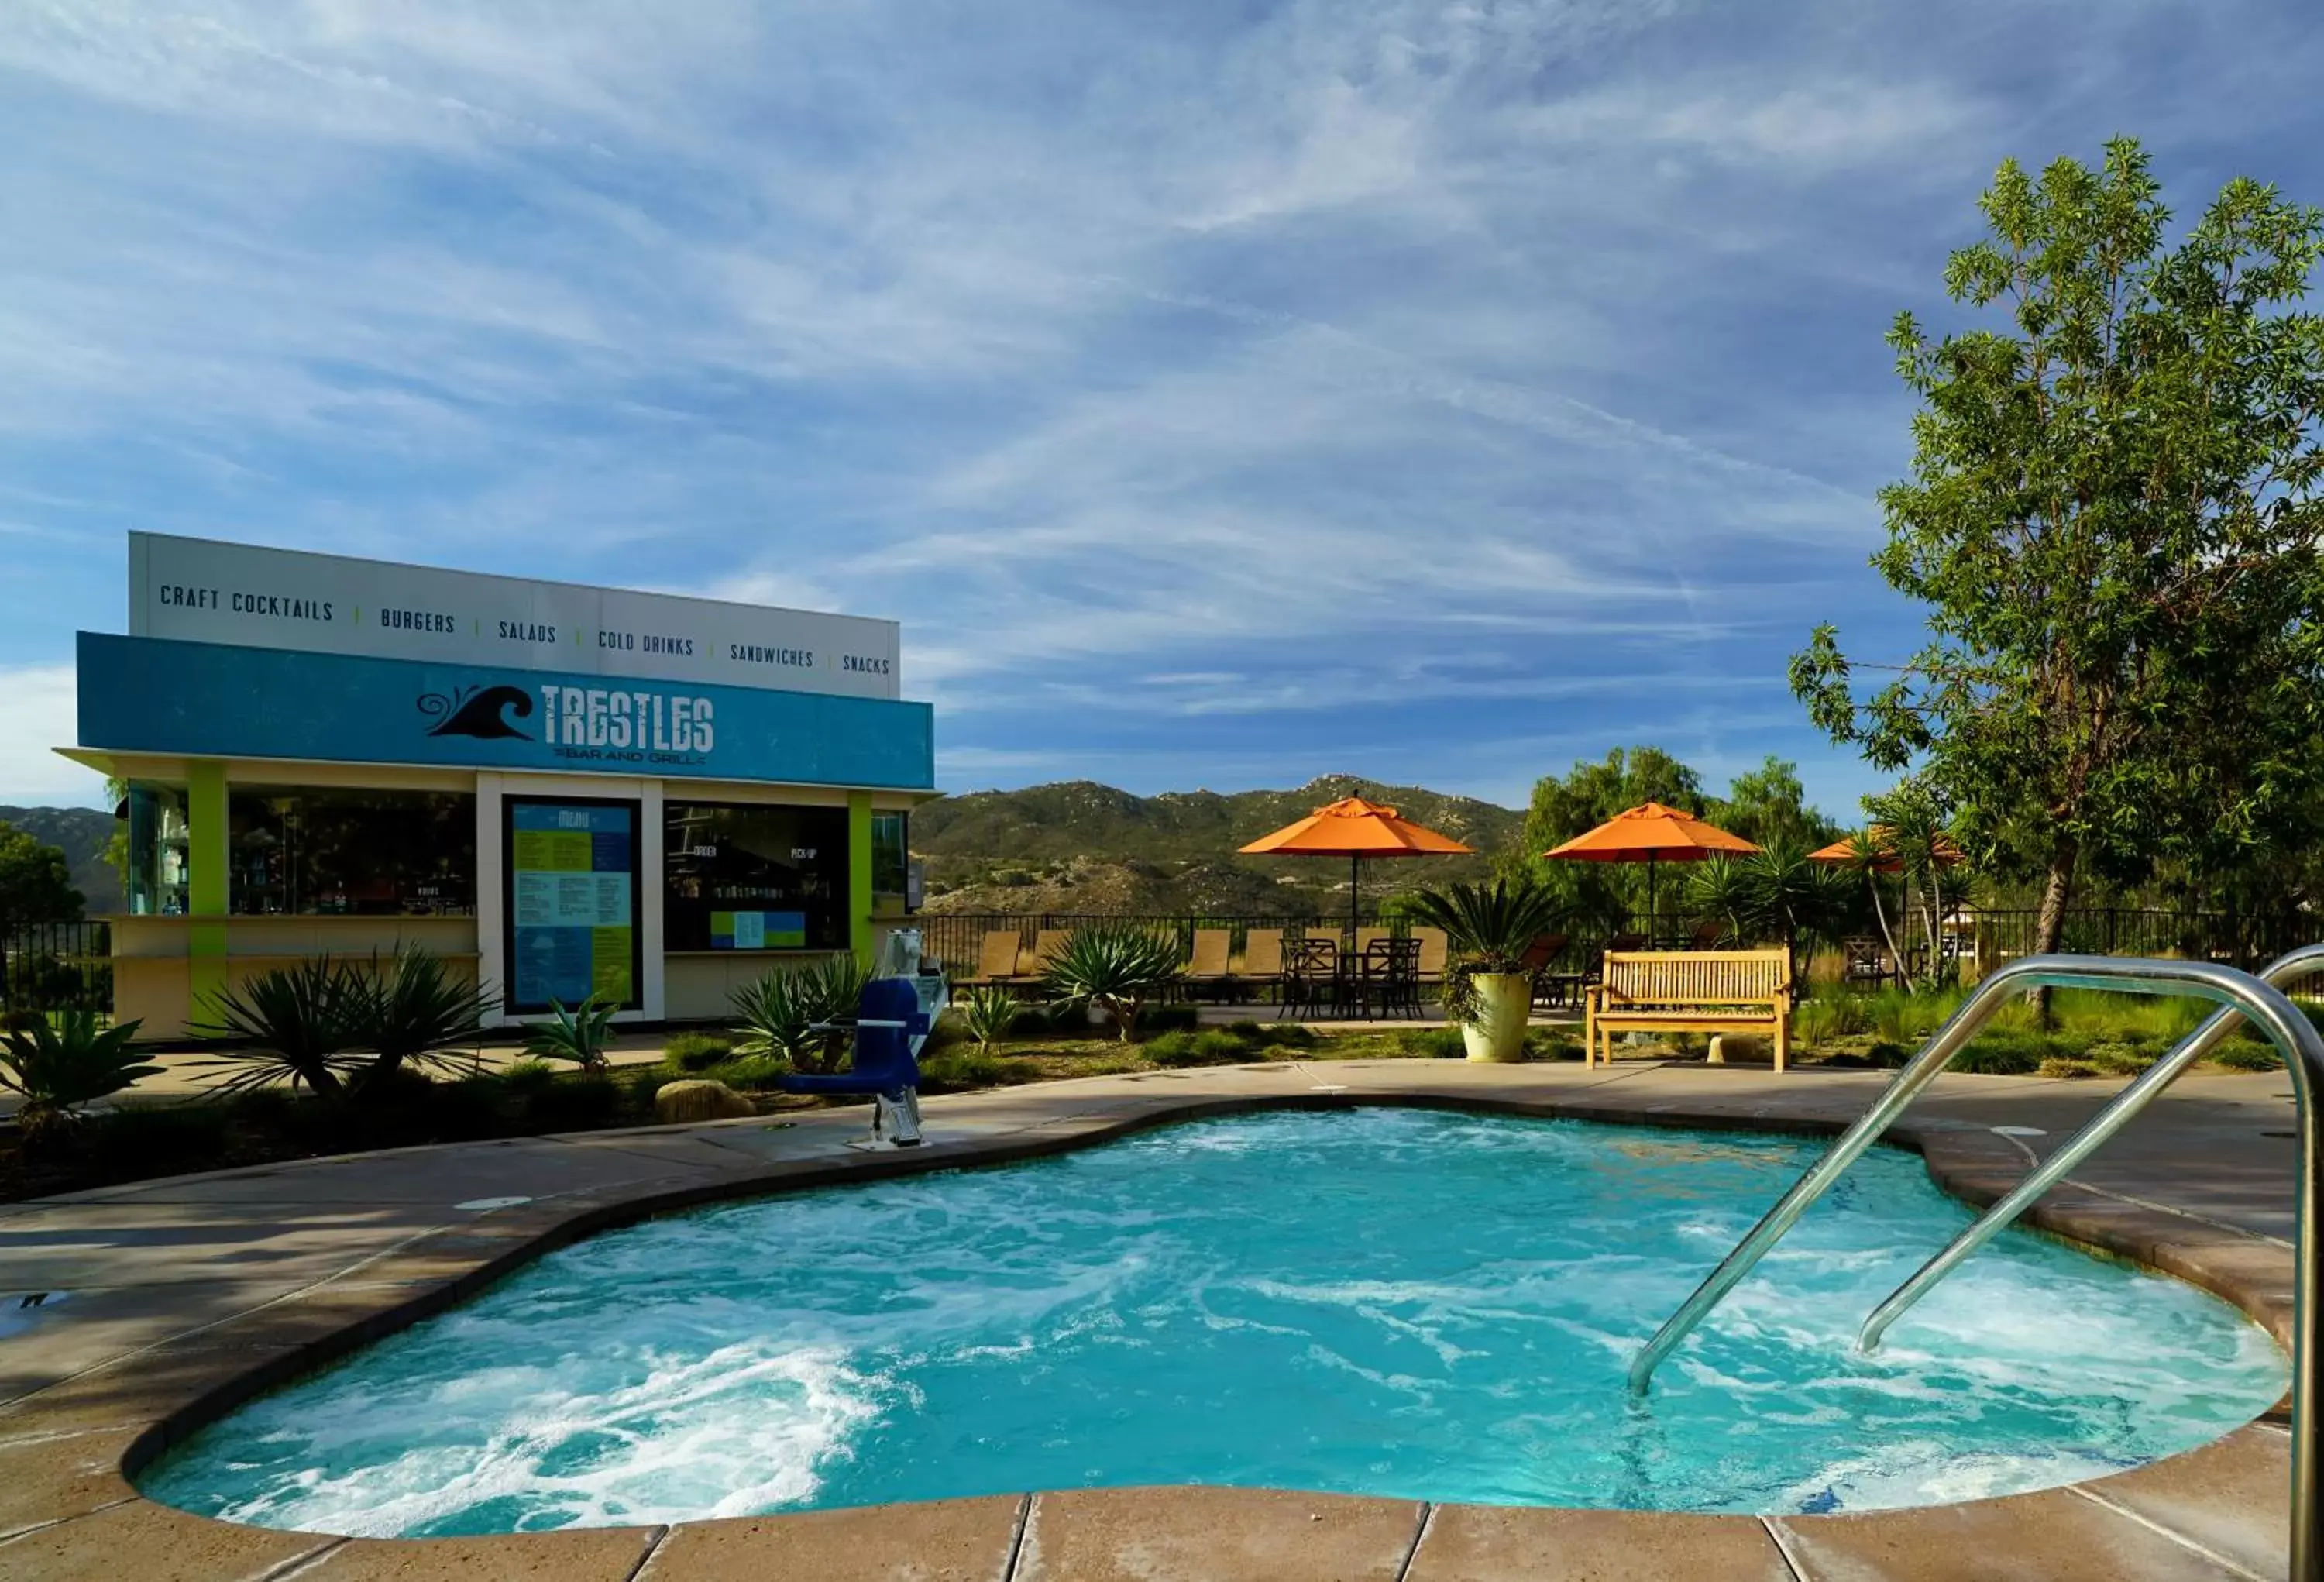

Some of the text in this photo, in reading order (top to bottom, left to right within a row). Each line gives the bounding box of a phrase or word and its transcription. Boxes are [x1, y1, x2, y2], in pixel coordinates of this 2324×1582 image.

[160, 585, 332, 621] CRAFT COCKTAILS
[381, 608, 456, 633] BURGERS
[499, 621, 556, 643] SALADS
[598, 630, 693, 656] COLD DRINKS
[731, 644, 813, 668] SANDWICHES
[843, 655, 889, 675] SNACKS
[541, 685, 713, 752] TRESTLES
[566, 748, 696, 765] BAR AND GRILL
[558, 809, 590, 828] MENU
